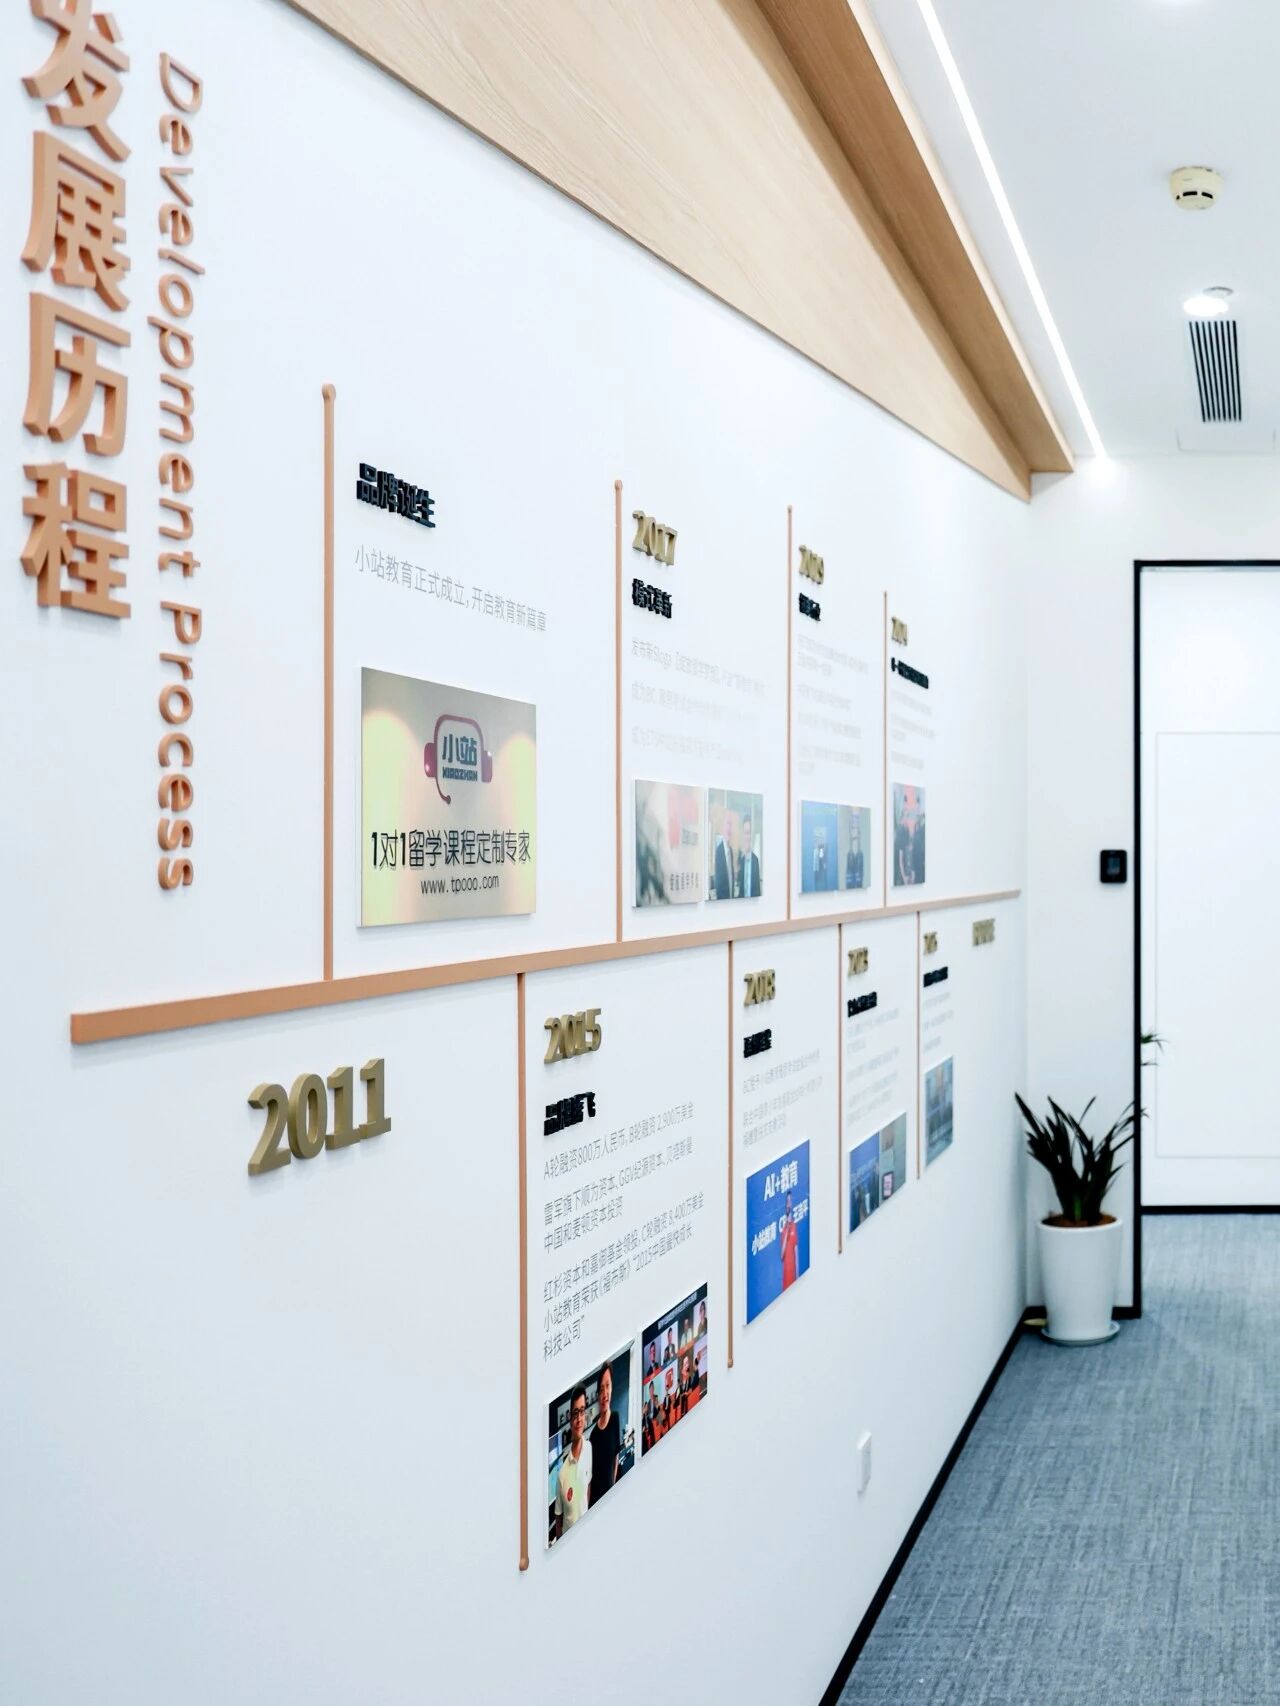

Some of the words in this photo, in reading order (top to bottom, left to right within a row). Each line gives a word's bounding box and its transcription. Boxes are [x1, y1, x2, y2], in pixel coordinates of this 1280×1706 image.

[20, 0, 131, 619] 发展历程
[147, 52, 205, 579] Development
[632, 510, 678, 566] 2017
[157, 601, 203, 891] Process
[442, 733, 478, 766] 小站
[371, 829, 533, 872] 1对1留学课程定制专家
[420, 874, 500, 895] www.tpooo.com
[544, 1008, 602, 1064] 2015
[247, 1058, 391, 1176] 2011
[764, 1159, 799, 1201] AI+教育
